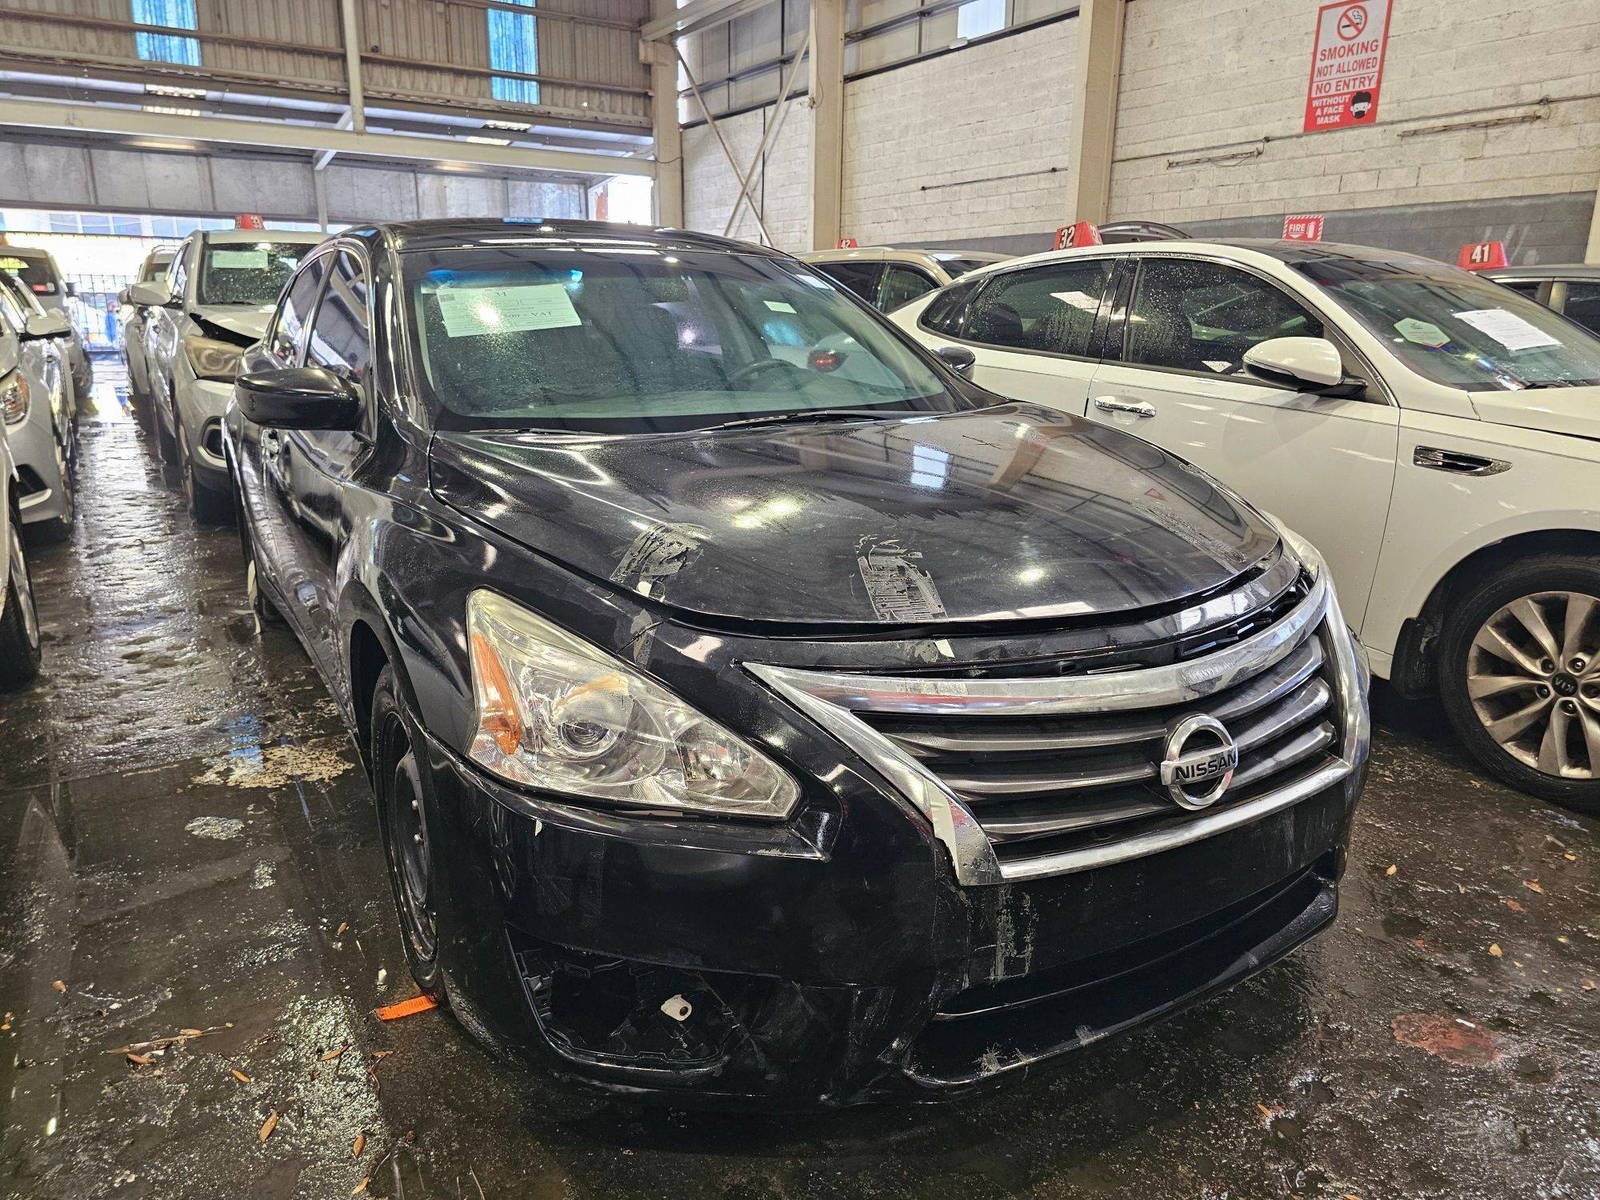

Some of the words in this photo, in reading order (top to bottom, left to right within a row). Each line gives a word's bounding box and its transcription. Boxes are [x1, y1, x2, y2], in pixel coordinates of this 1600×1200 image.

[1320, 39, 1378, 61] SMOKING
[1316, 64, 1334, 78] NOT
[1335, 57, 1377, 74] ALLOWED
[1315, 82, 1331, 95] NO
[1335, 75, 1374, 92] ENTRY
[1312, 95, 1350, 107] WITHOUT
[1322, 104, 1344, 114] FACE
[1316, 115, 1340, 124] MASK
[1289, 223, 1306, 232] FIRE
[1060, 226, 1075, 249] 32
[1471, 244, 1489, 263] 41
[1176, 753, 1236, 780] NISSAN
